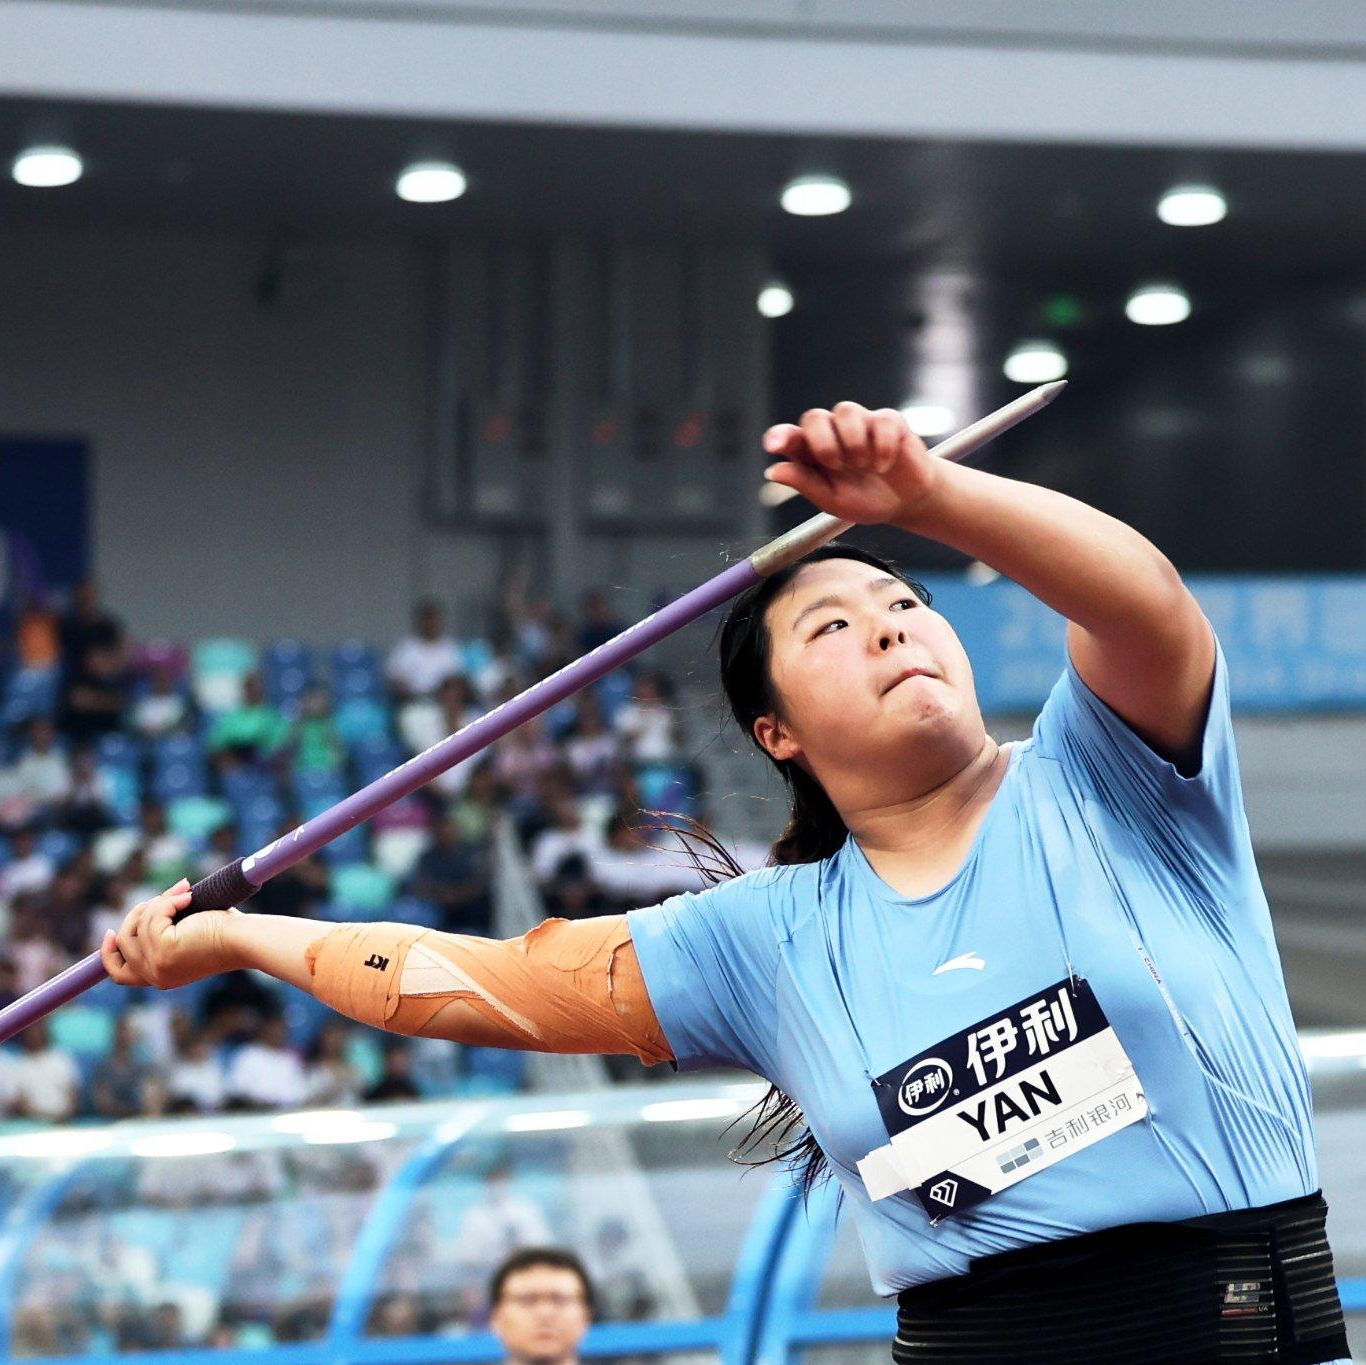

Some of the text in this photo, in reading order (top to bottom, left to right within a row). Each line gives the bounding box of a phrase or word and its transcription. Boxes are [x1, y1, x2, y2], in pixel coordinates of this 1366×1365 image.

[967, 988, 1079, 1086] 伊利
[904, 1068, 946, 1106] 伊利
[956, 1070, 1063, 1142] YAN
[1044, 1093, 1132, 1149] 吉利银河
